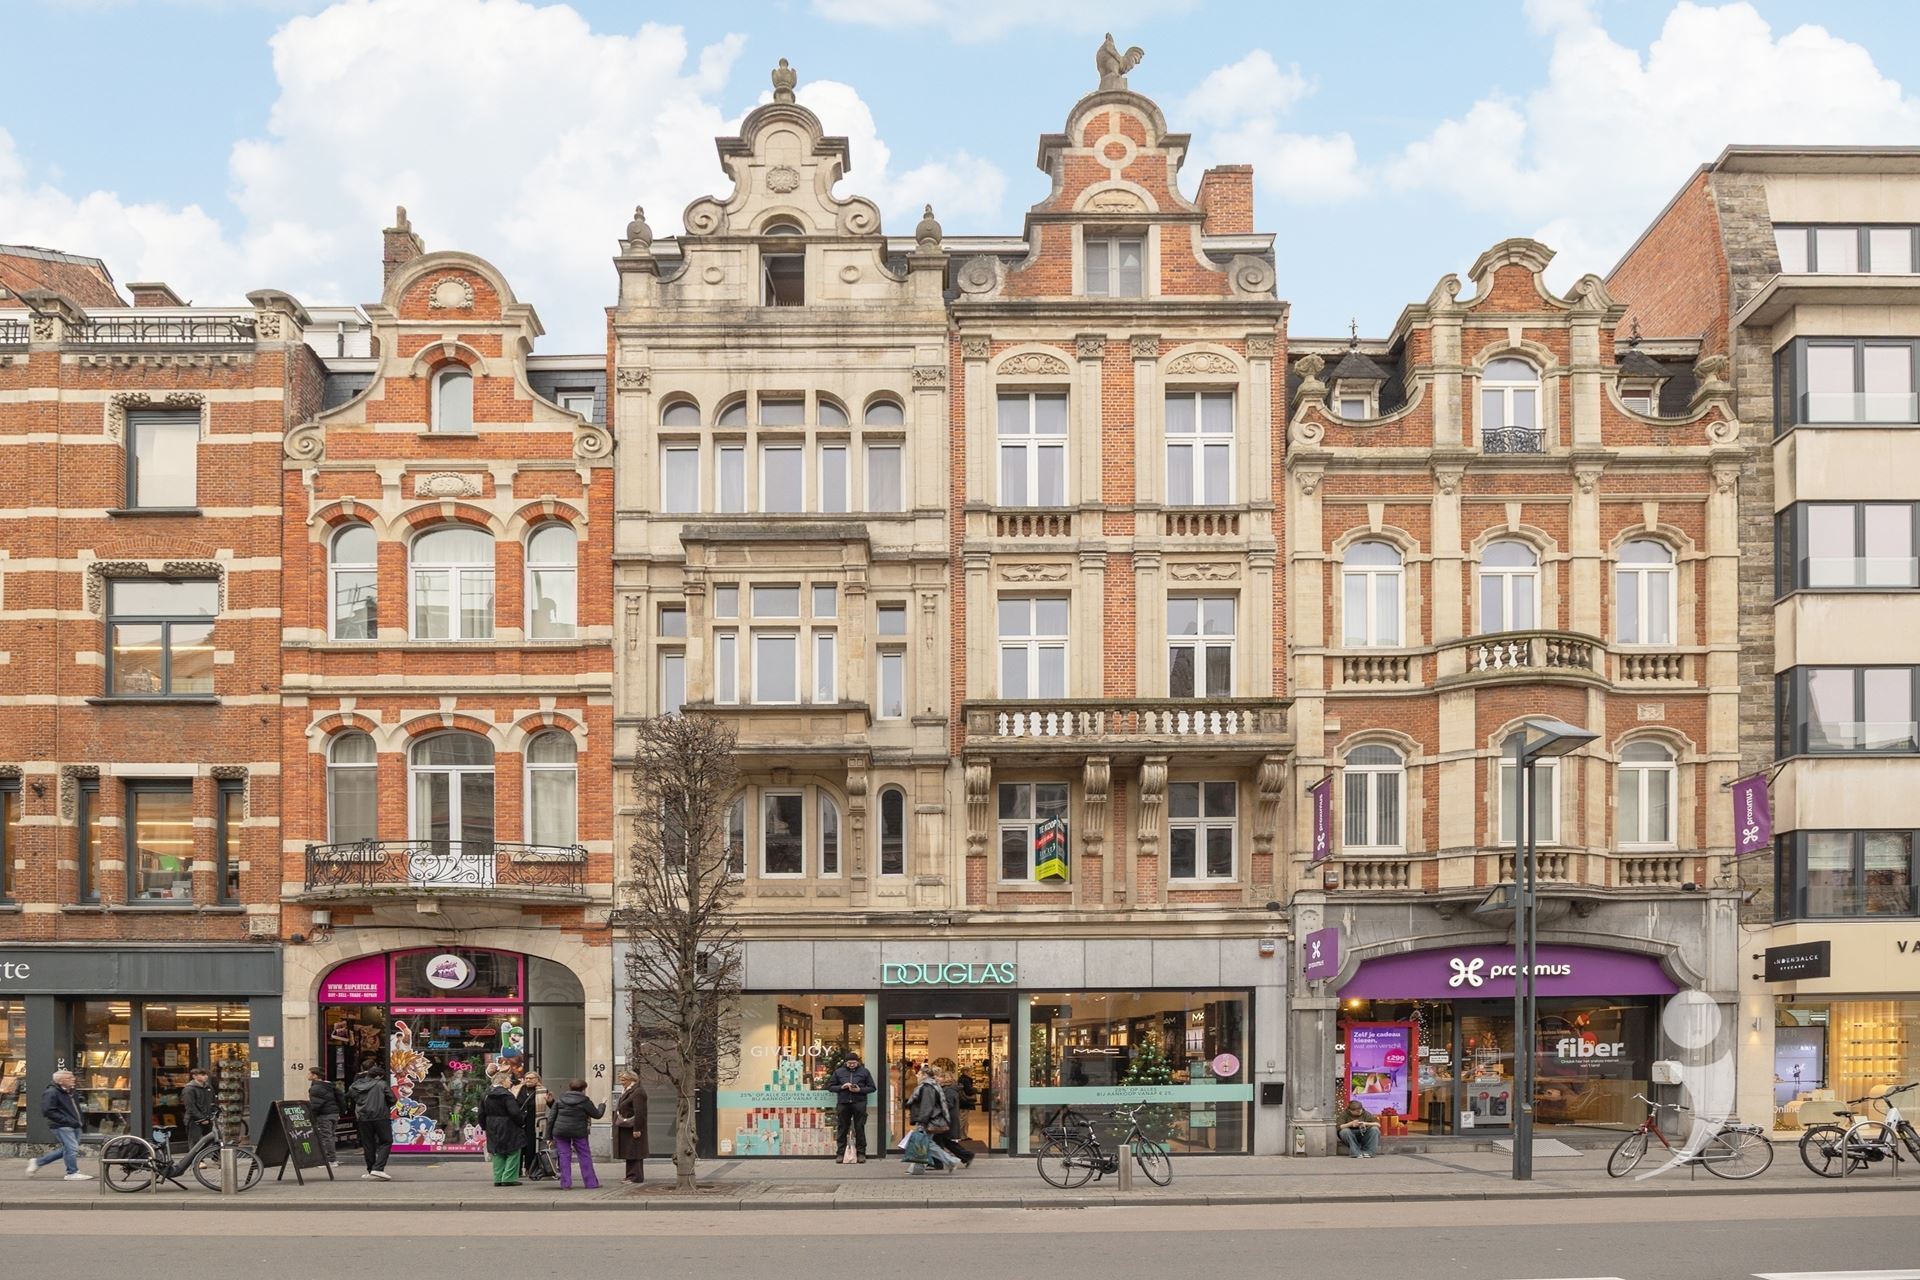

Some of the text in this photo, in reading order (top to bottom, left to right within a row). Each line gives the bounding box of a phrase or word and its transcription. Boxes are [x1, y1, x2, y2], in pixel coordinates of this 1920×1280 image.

[1746, 788, 1755, 826] proximus
[0, 961, 30, 980] te
[882, 962, 1015, 984] DOUGLAS
[1490, 964, 1571, 979] proxmus
[751, 1045, 832, 1057] GIVE JOY
[1556, 1037, 1624, 1058] fiber
[291, 1063, 304, 1071] 49
[449, 1061, 472, 1072] open
[592, 1063, 605, 1071] 49
